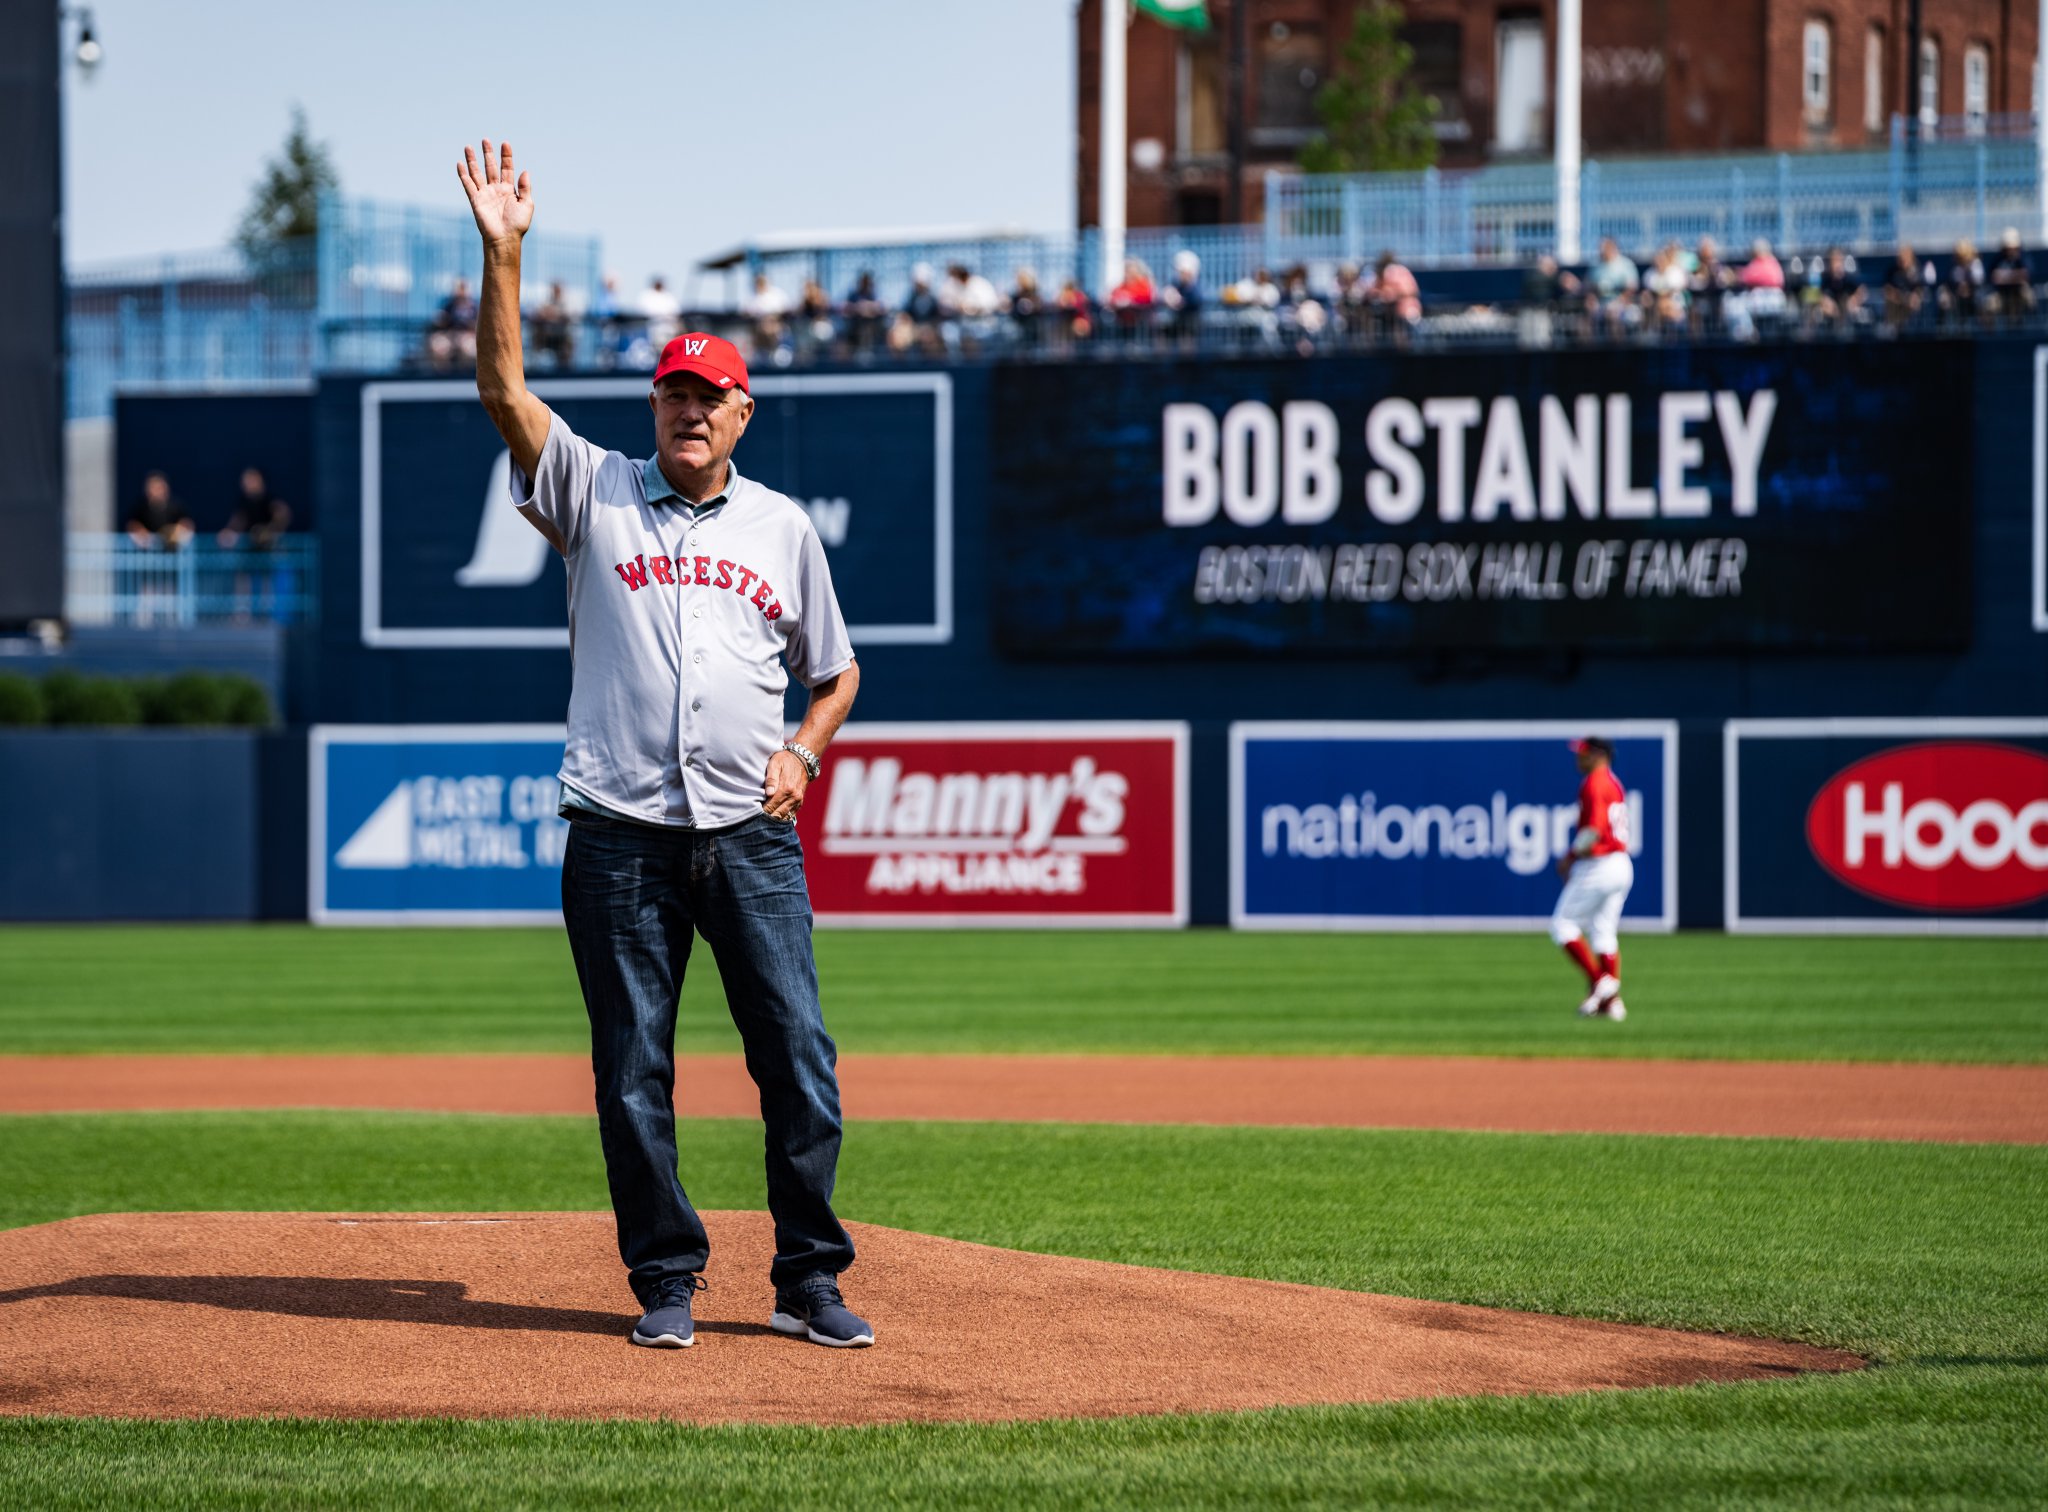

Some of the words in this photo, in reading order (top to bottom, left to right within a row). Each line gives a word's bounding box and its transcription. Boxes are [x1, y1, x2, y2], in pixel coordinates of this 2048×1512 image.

[684, 338, 709, 356] W
[1162, 400, 1341, 526] BOB
[1364, 389, 1778, 524] STANLEY
[615, 554, 783, 629] WRCESTER
[1194, 544, 1333, 603] BOSTON
[1330, 543, 1402, 601] RED
[1403, 541, 1478, 601] SOX
[1477, 541, 1566, 599] HALL
[1573, 539, 1626, 599] OF
[1624, 537, 1748, 598] FAMER
[414, 774, 505, 821] EAST
[822, 756, 1128, 852] Manny's
[415, 821, 530, 869] METAL
[1261, 790, 1644, 876] nationalgr
[866, 852, 1086, 894] APPLIANCE
